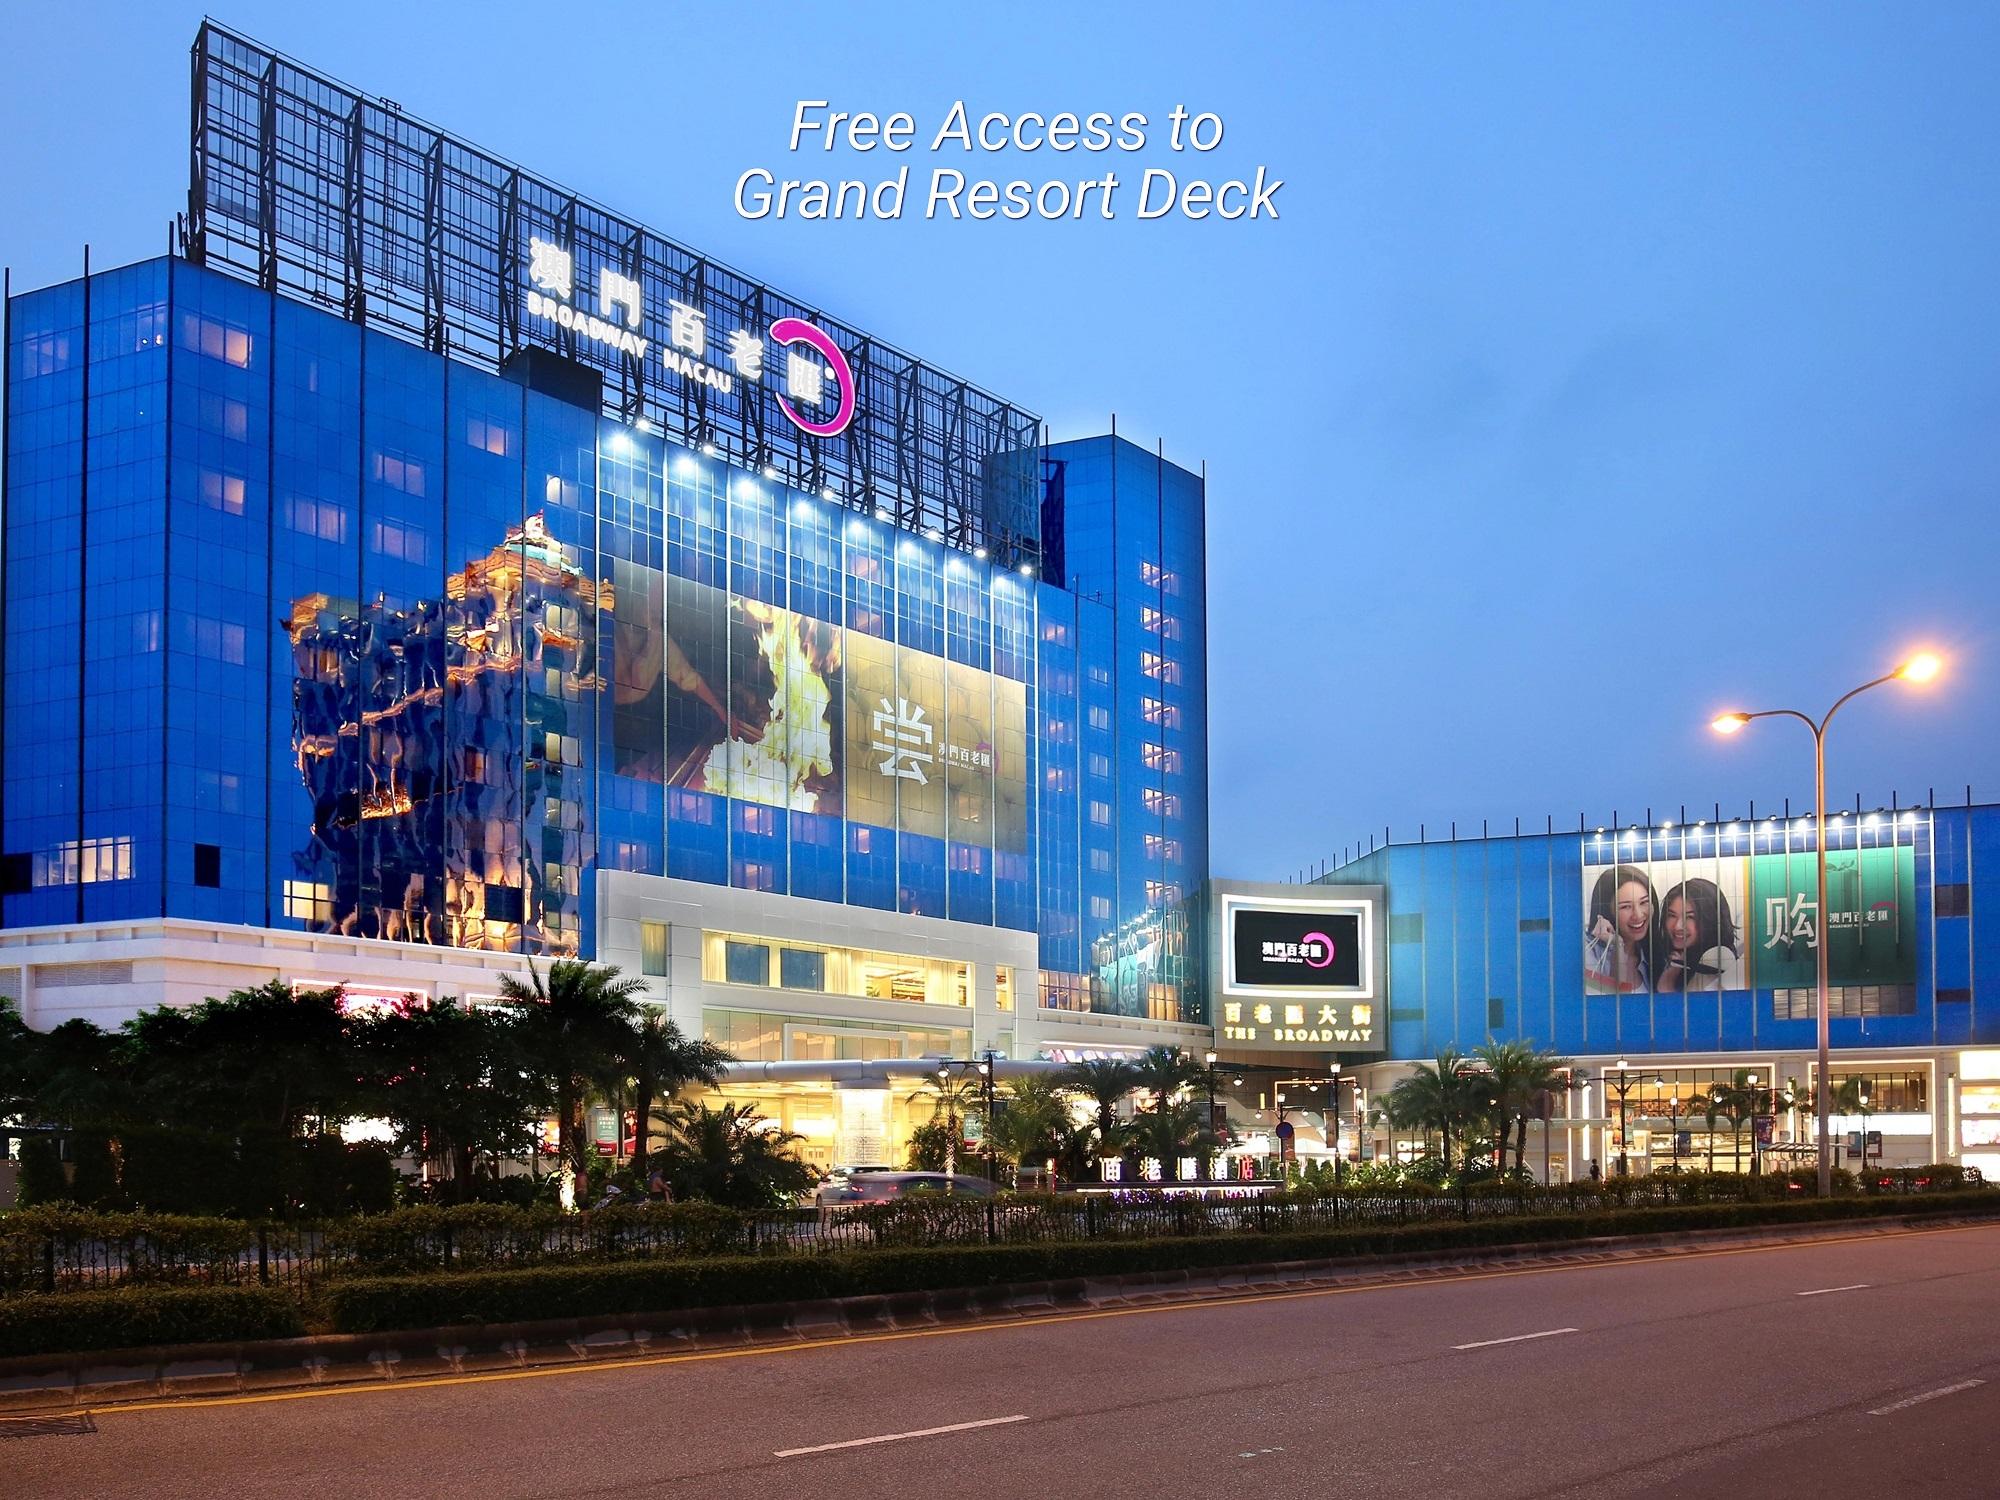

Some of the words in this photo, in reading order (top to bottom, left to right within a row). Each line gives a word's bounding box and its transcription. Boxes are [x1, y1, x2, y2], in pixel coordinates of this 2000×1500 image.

[527, 291, 648, 359] BROADWAY
[663, 348, 732, 393] MACAU
[529, 236, 822, 405] 澳門百老匯
[1224, 1027, 1256, 1041] THE
[1274, 1028, 1372, 1042] BROADWAY
